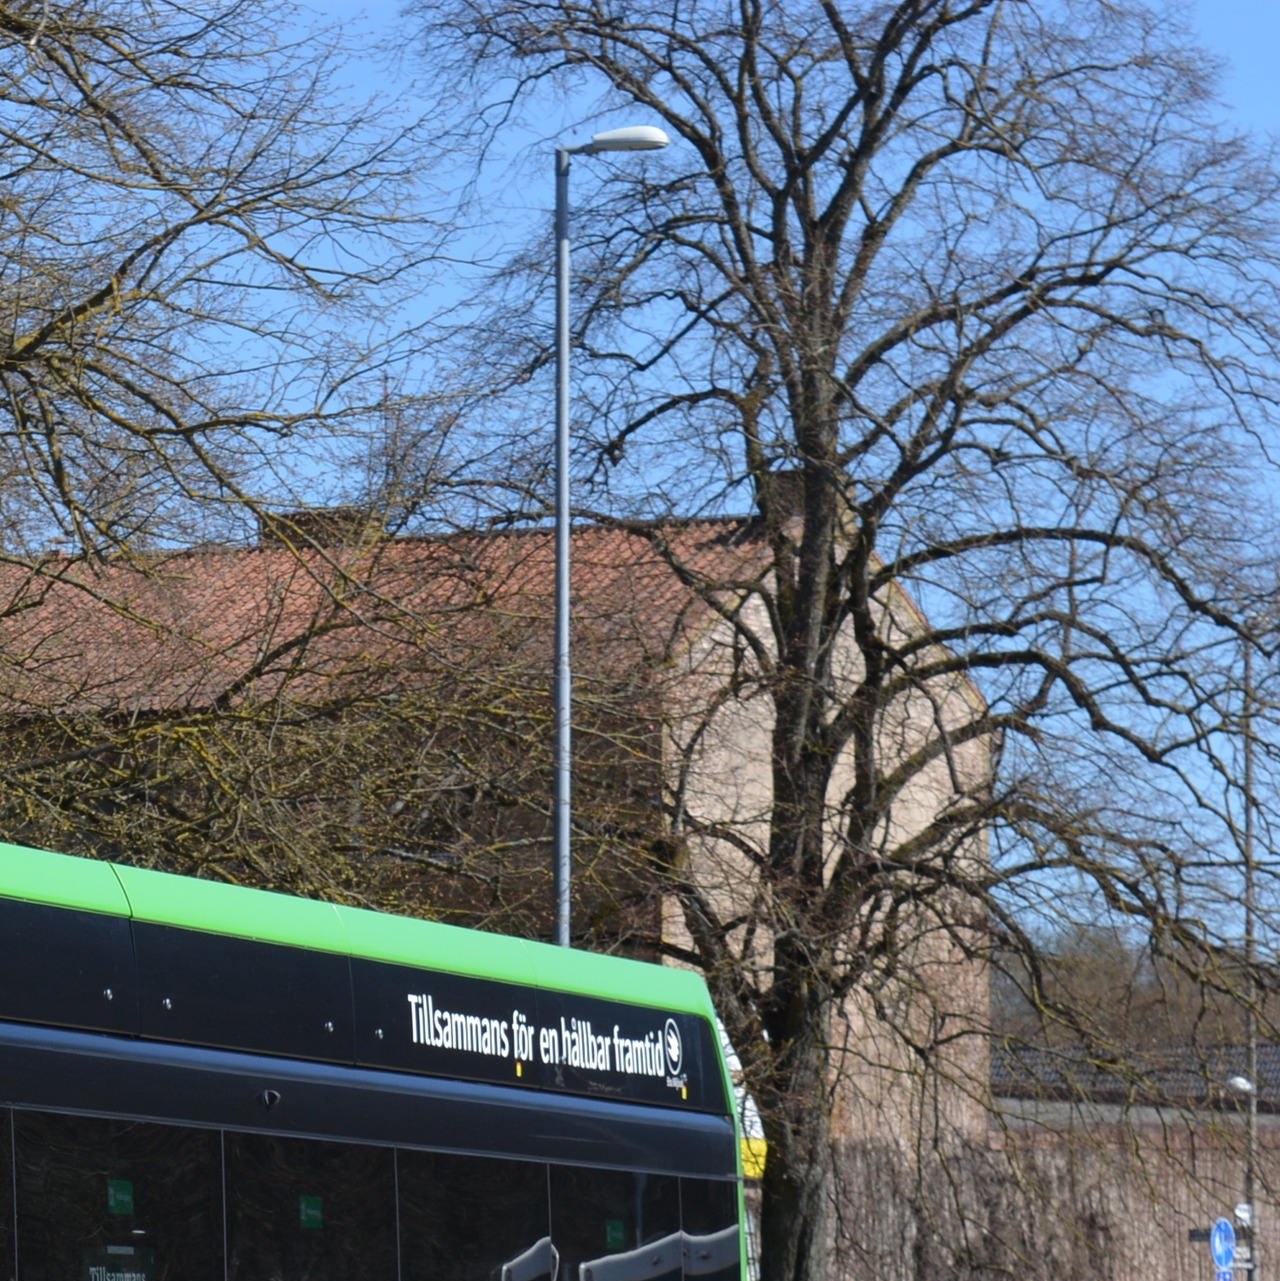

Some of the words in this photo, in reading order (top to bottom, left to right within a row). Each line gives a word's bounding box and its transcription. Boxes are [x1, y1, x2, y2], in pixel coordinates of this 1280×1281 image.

[408, 994, 508, 1058] Tillsammans
[512, 1010, 534, 1062] för
[540, 1026, 560, 1065] en
[560, 1016, 610, 1071] hållbar
[613, 1025, 665, 1077] framtid
